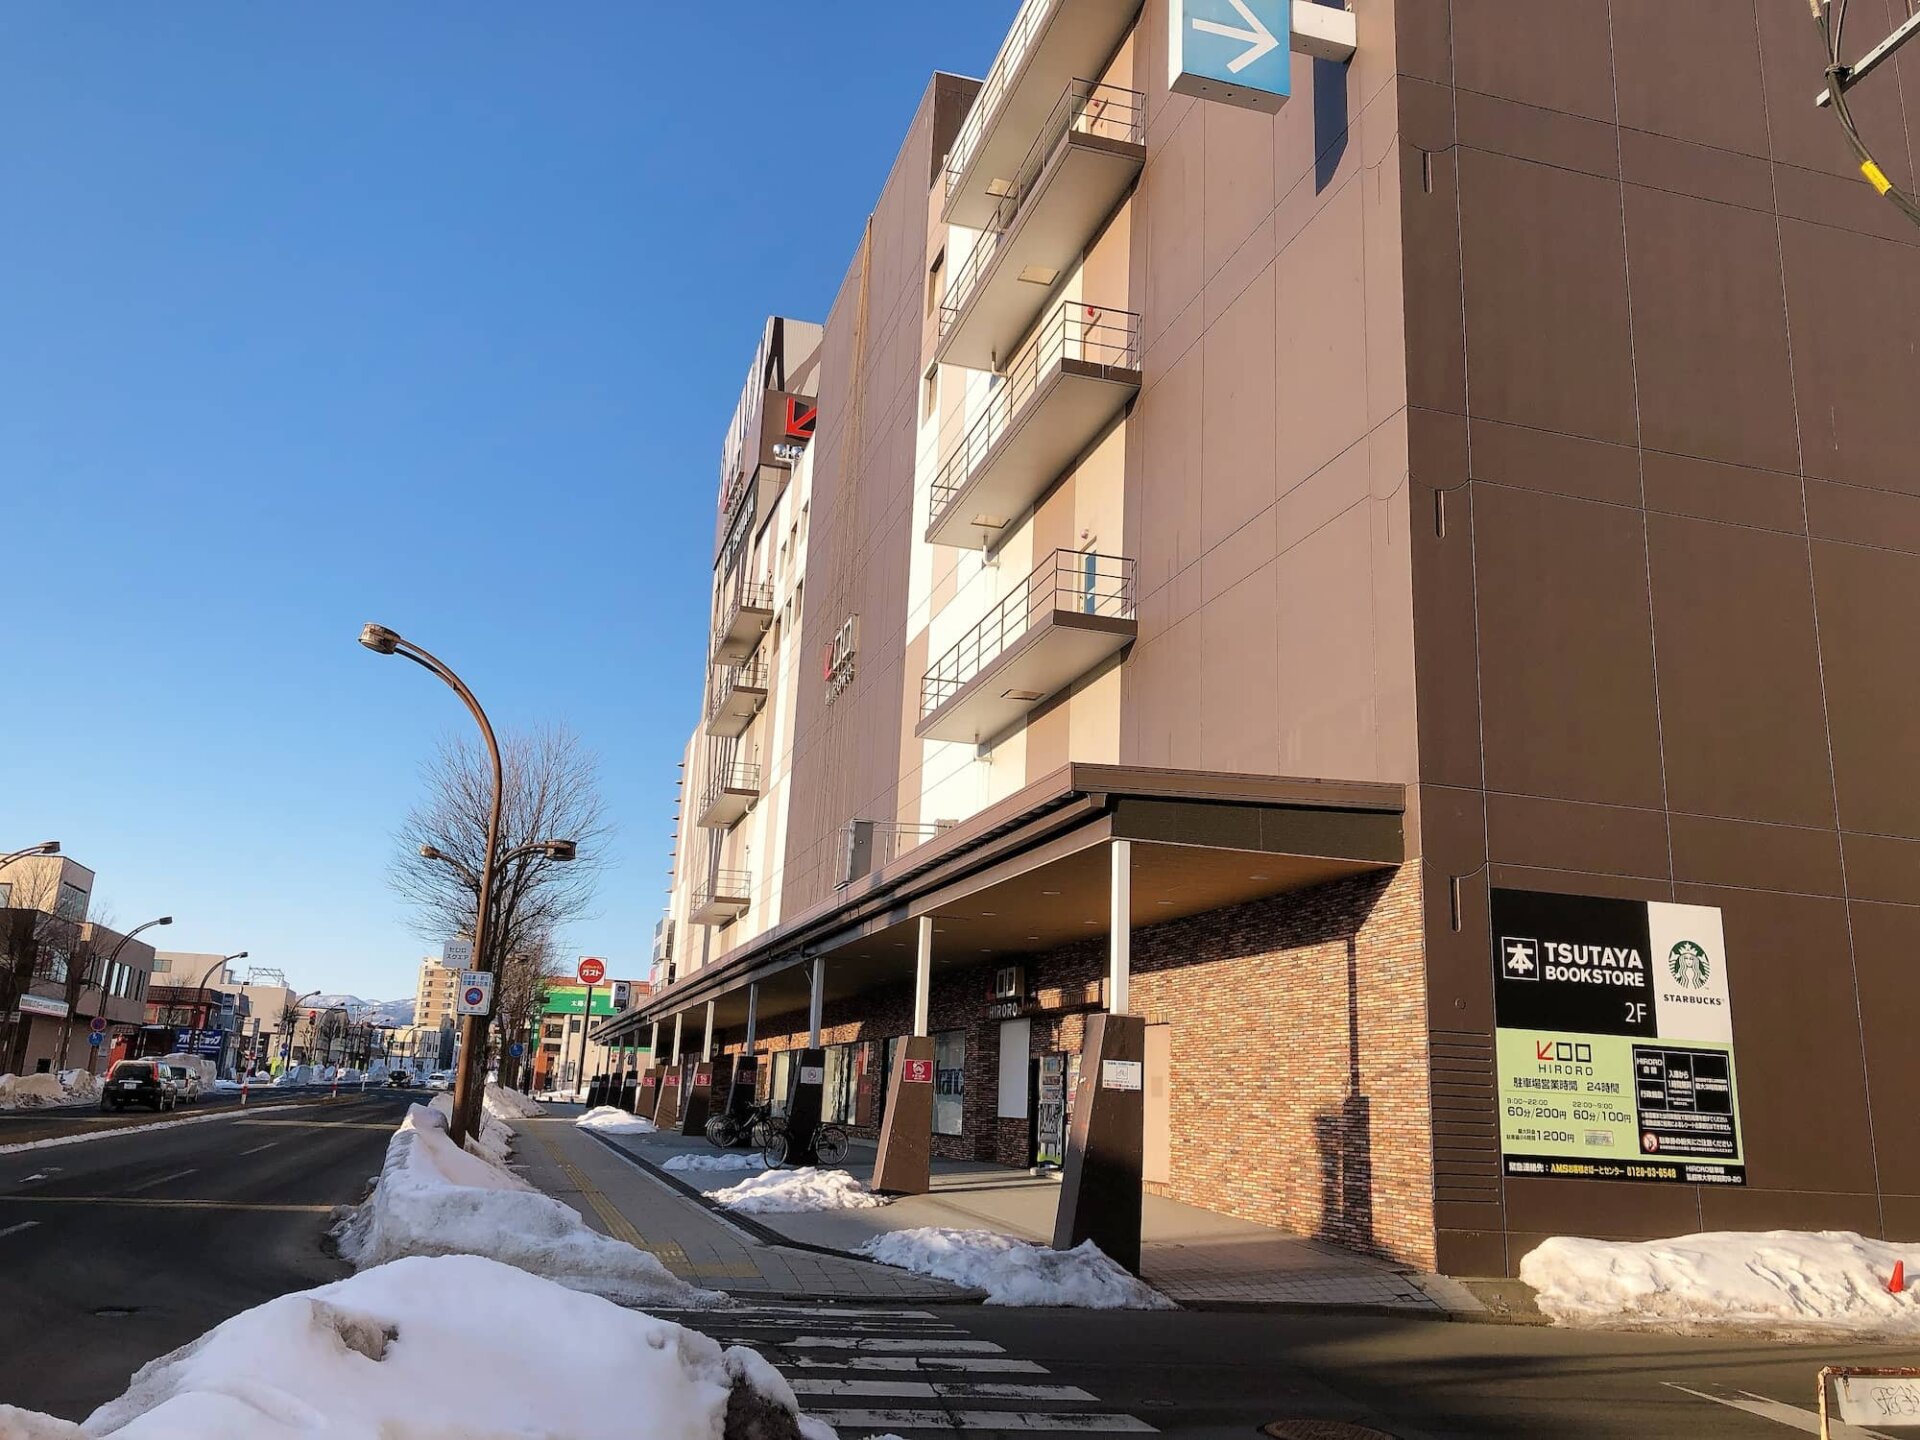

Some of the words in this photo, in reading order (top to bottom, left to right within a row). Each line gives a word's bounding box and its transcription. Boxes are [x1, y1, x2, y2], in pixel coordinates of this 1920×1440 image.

[1506, 943, 1534, 975] 本
[1544, 943, 1644, 969] TSUTAYA
[582, 969, 602, 977] ガスト
[1545, 966, 1645, 987] BOOKSTORE
[1663, 993, 1723, 1006] STARBUCKS
[989, 1002, 1018, 1019] HIRORO
[1625, 1002, 1647, 1023] 2F
[1538, 1064, 1594, 1076] HIRORO
[1513, 1076, 1578, 1092] 駐車場営業時間
[1586, 1081, 1620, 1095] 24時間
[1507, 1106, 1567, 1120] 60分/200円
[1573, 1109, 1632, 1124] 60分/100円
[1536, 1129, 1575, 1143] 1200円
